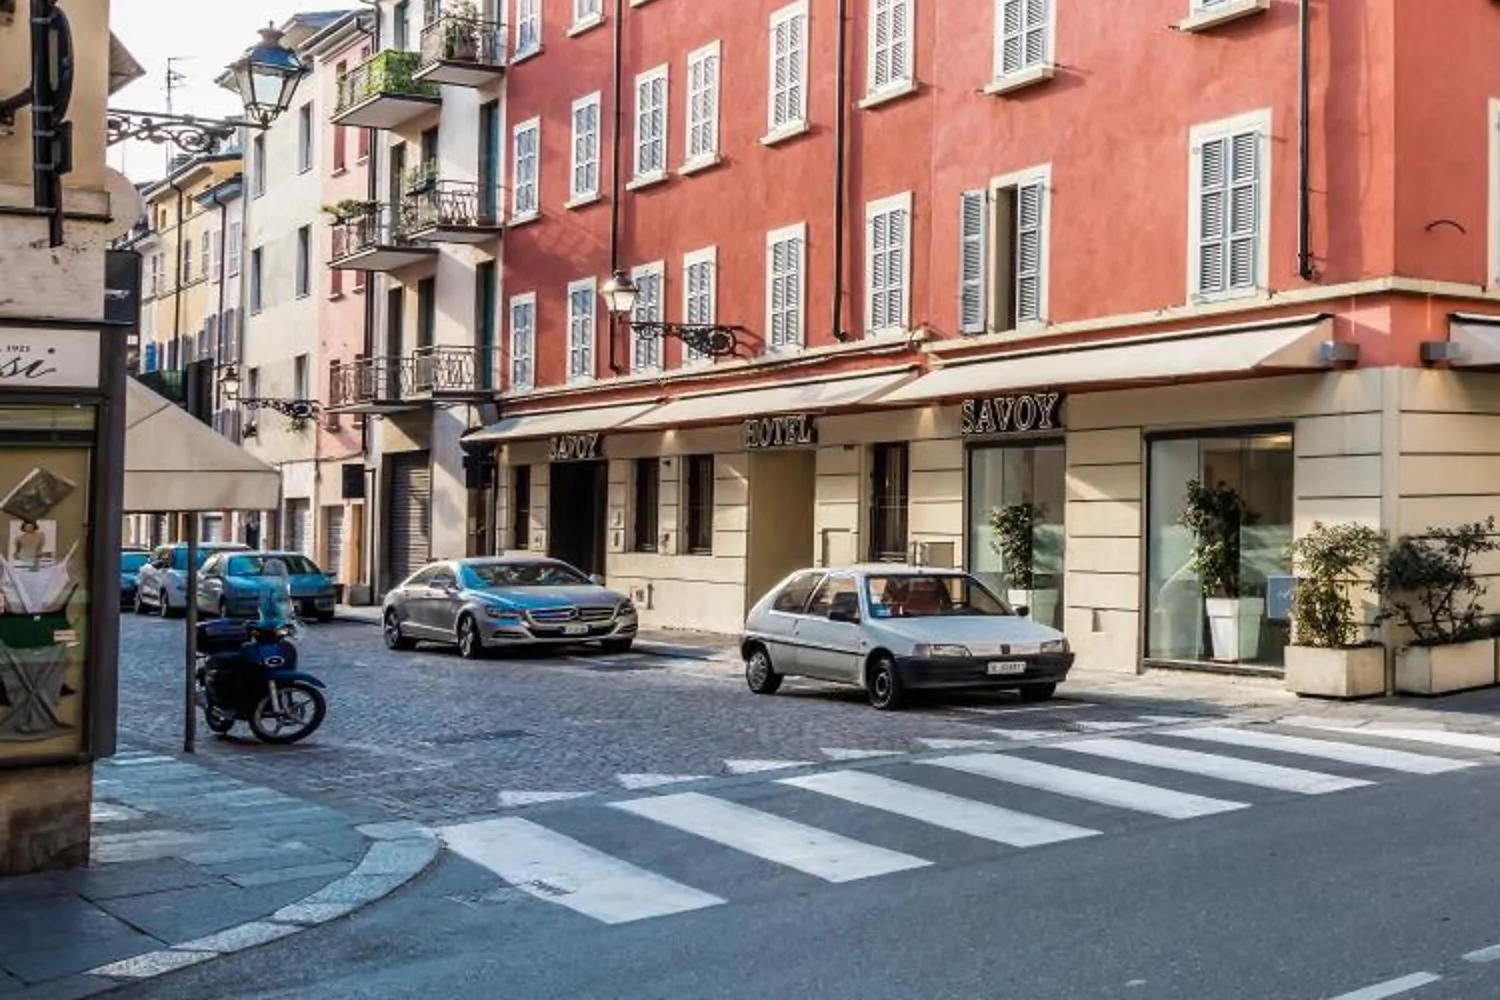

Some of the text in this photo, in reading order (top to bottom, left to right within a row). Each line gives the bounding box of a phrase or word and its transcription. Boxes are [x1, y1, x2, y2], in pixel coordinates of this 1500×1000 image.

[961, 392, 1059, 434] SAVOY
[548, 432, 600, 460] SAVOY
[743, 414, 812, 448] HOTEL
